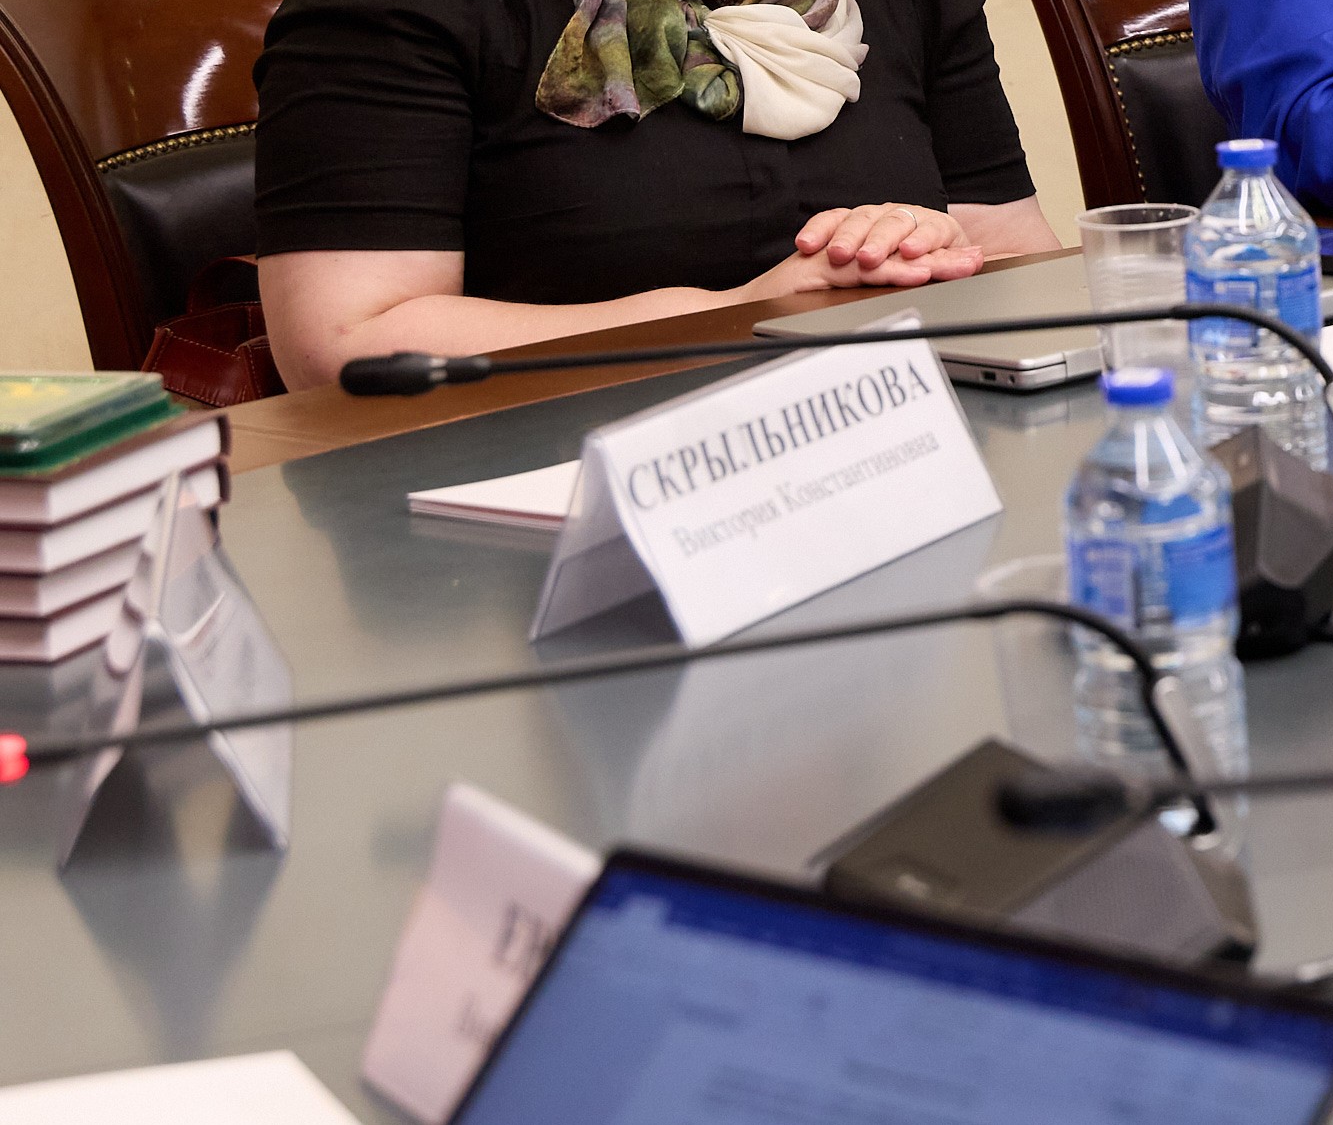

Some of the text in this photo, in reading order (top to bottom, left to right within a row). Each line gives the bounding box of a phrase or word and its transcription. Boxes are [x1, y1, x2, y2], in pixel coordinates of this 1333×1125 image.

[628, 360, 932, 512] СКРЫЛЬНИКОВА
[671, 431, 940, 558] Виктория Константиновна
